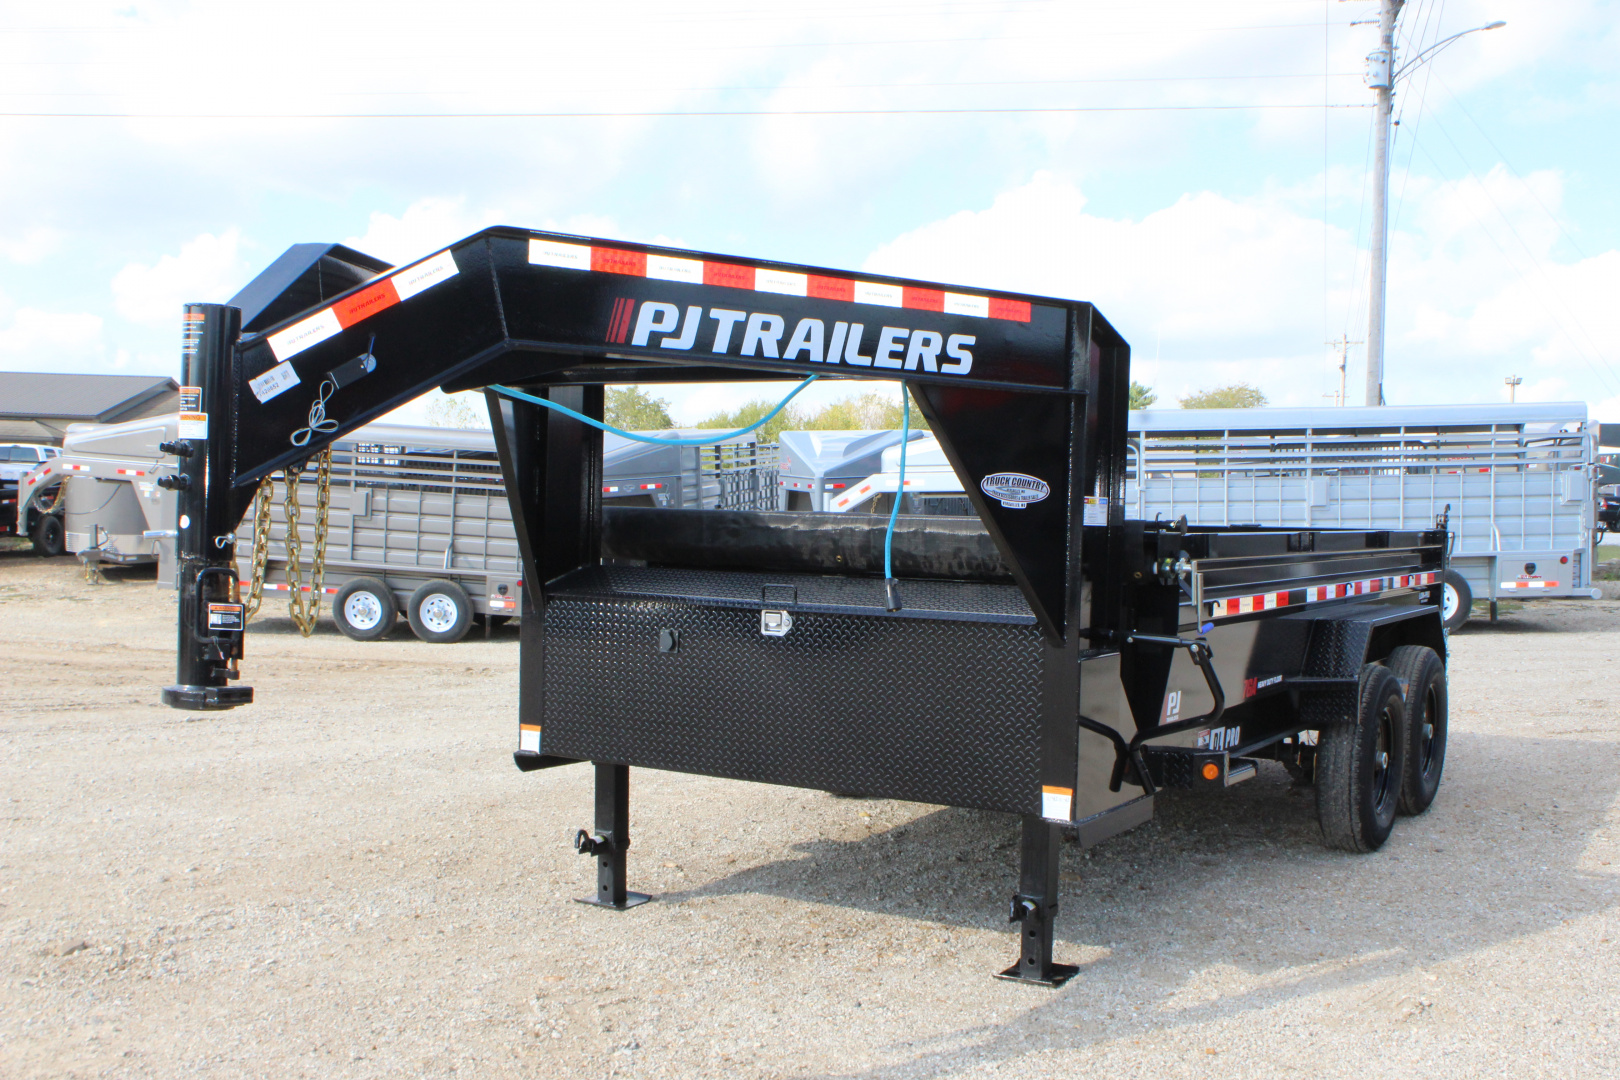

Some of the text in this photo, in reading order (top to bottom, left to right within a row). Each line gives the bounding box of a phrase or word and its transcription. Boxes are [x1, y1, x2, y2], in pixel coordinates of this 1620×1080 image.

[632, 301, 976, 375] PJ TRAILERS
[986, 476, 1045, 490] TRUCK COUNTRY
[1166, 690, 1182, 716] PJ
[1226, 726, 1240, 748] PRO
